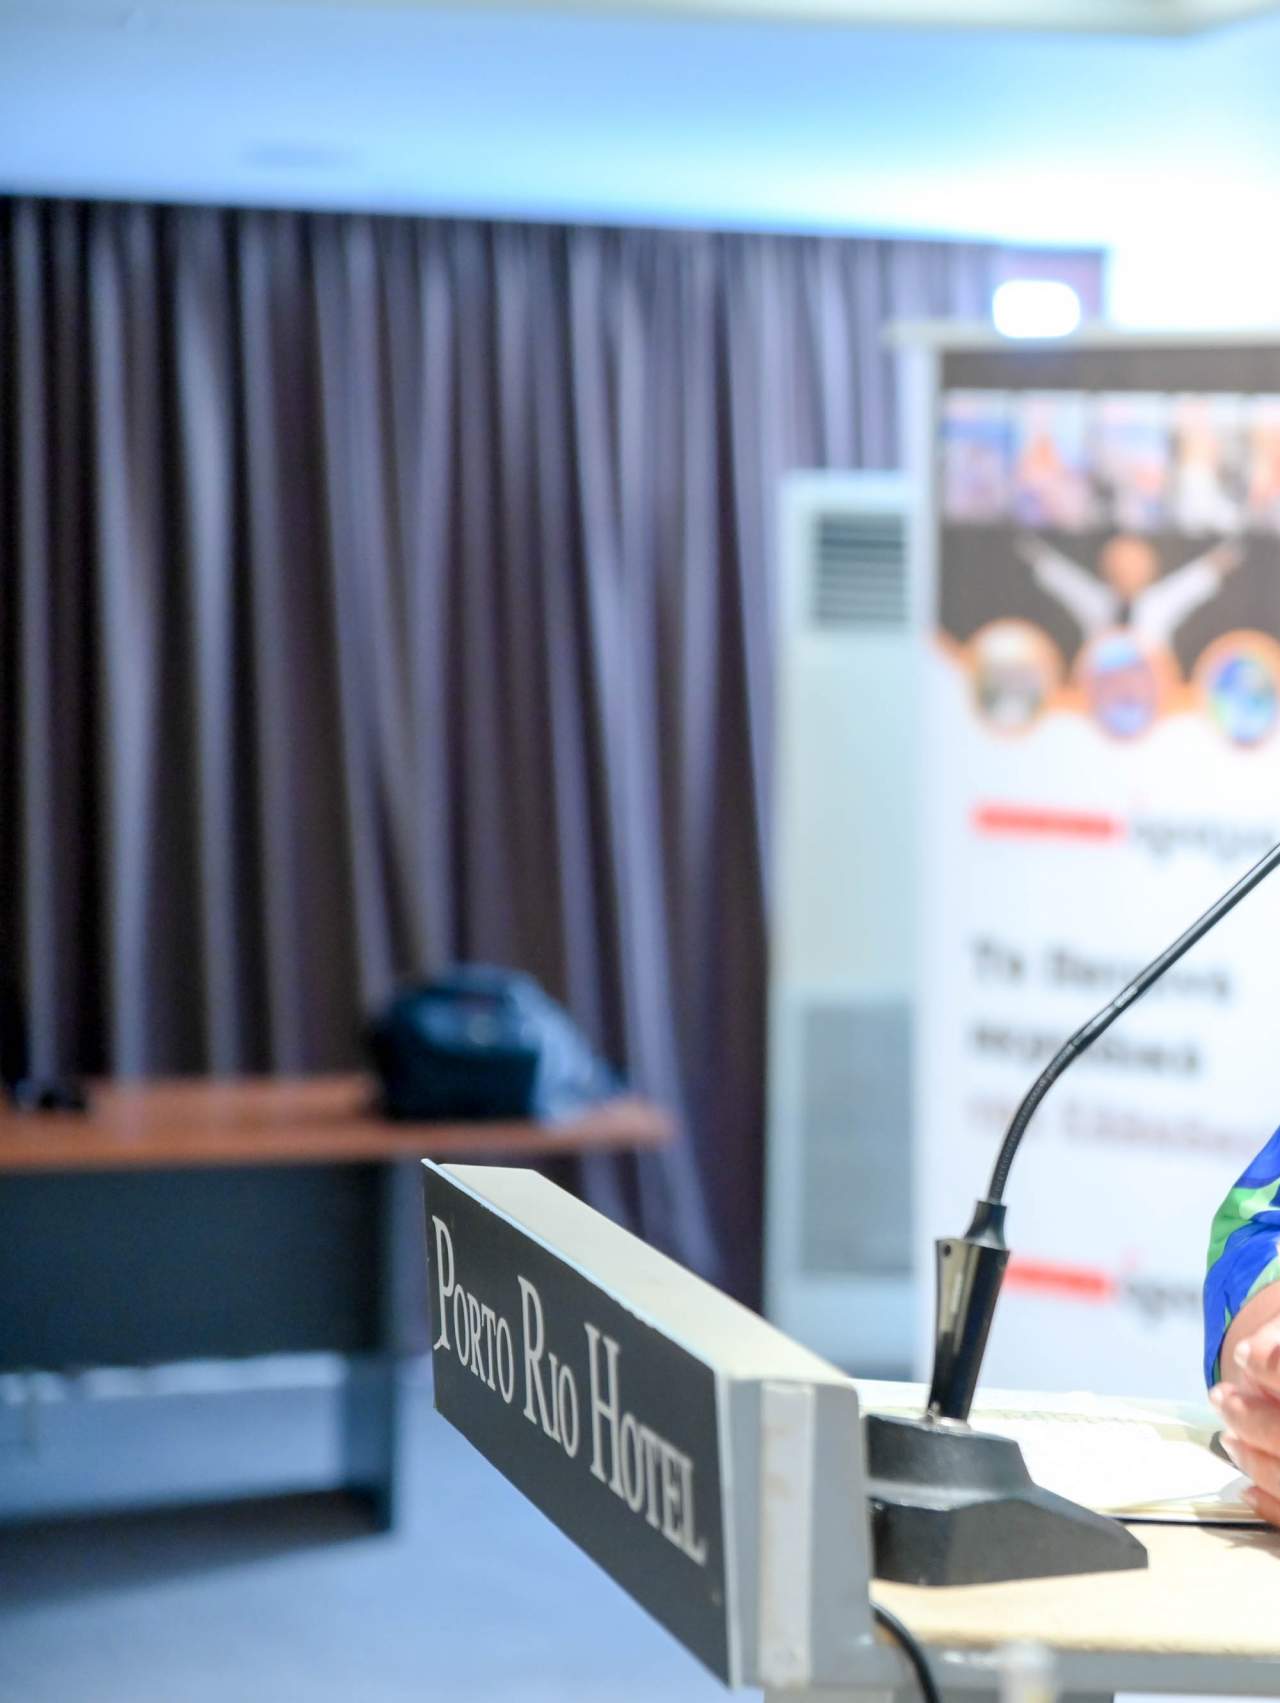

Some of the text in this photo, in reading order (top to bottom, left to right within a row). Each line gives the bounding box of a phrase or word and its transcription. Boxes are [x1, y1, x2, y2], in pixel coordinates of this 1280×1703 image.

[432, 1215, 706, 1564] PORTO RIO HOTEL
